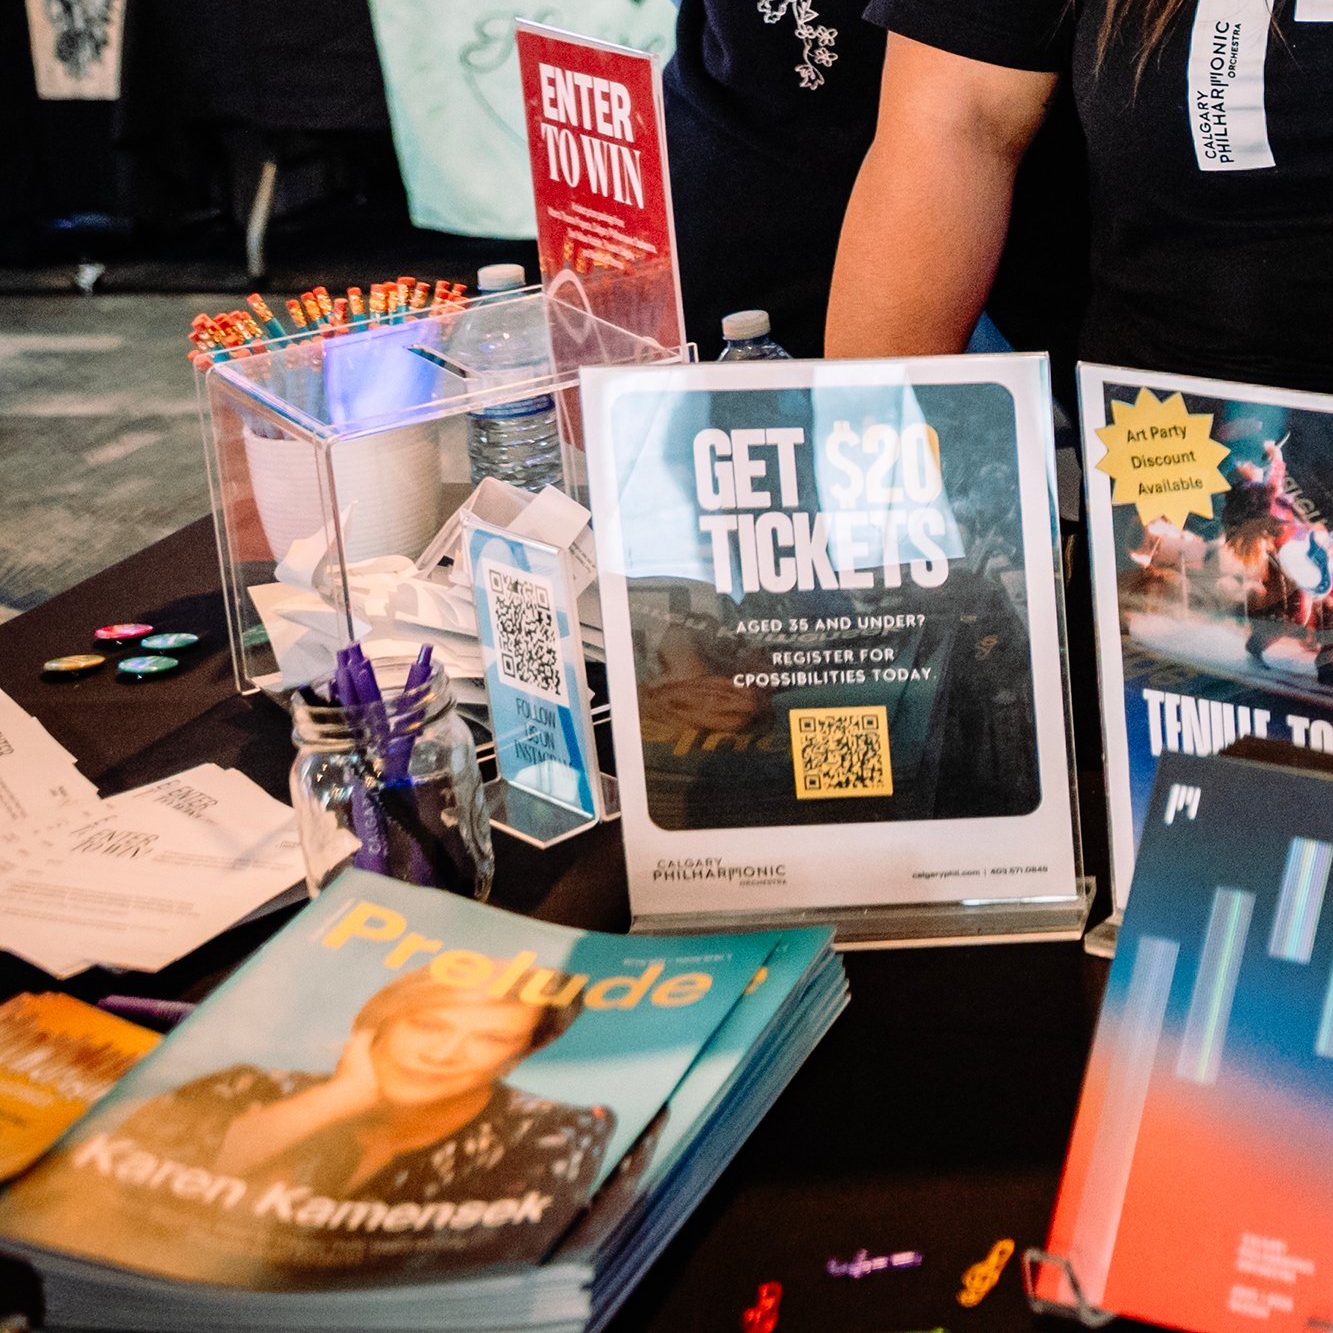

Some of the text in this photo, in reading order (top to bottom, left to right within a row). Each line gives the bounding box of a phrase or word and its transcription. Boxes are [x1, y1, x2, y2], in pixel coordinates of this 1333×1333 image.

[1228, 23, 1242, 79] ORCHESTRA
[538, 62, 635, 143] ENTER
[1210, 21, 1235, 163] PHILHARMONIC
[1197, 90, 1217, 159] CALGARY
[540, 122, 644, 209] TO WIN
[1127, 423, 1187, 443] Art Party
[693, 420, 942, 510] GET $20
[1131, 450, 1196, 469] Discount
[1138, 475, 1203, 496] Available
[698, 510, 951, 594] TICKETS
[736, 614, 926, 635] AGED 35 AND UNDER?
[773, 648, 894, 666] REGISTER FOR
[733, 669, 865, 689] CPOSSIBILITIES
[515, 697, 556, 729] FOLLOW
[539, 730, 556, 750] ON
[89, 828, 160, 847] ENTER
[653, 864, 786, 882] PHILHARMONIC
[657, 857, 722, 869] CALGARY
[322, 900, 713, 1011] Prelude
[72, 1134, 554, 1232] Karen Kamensek
